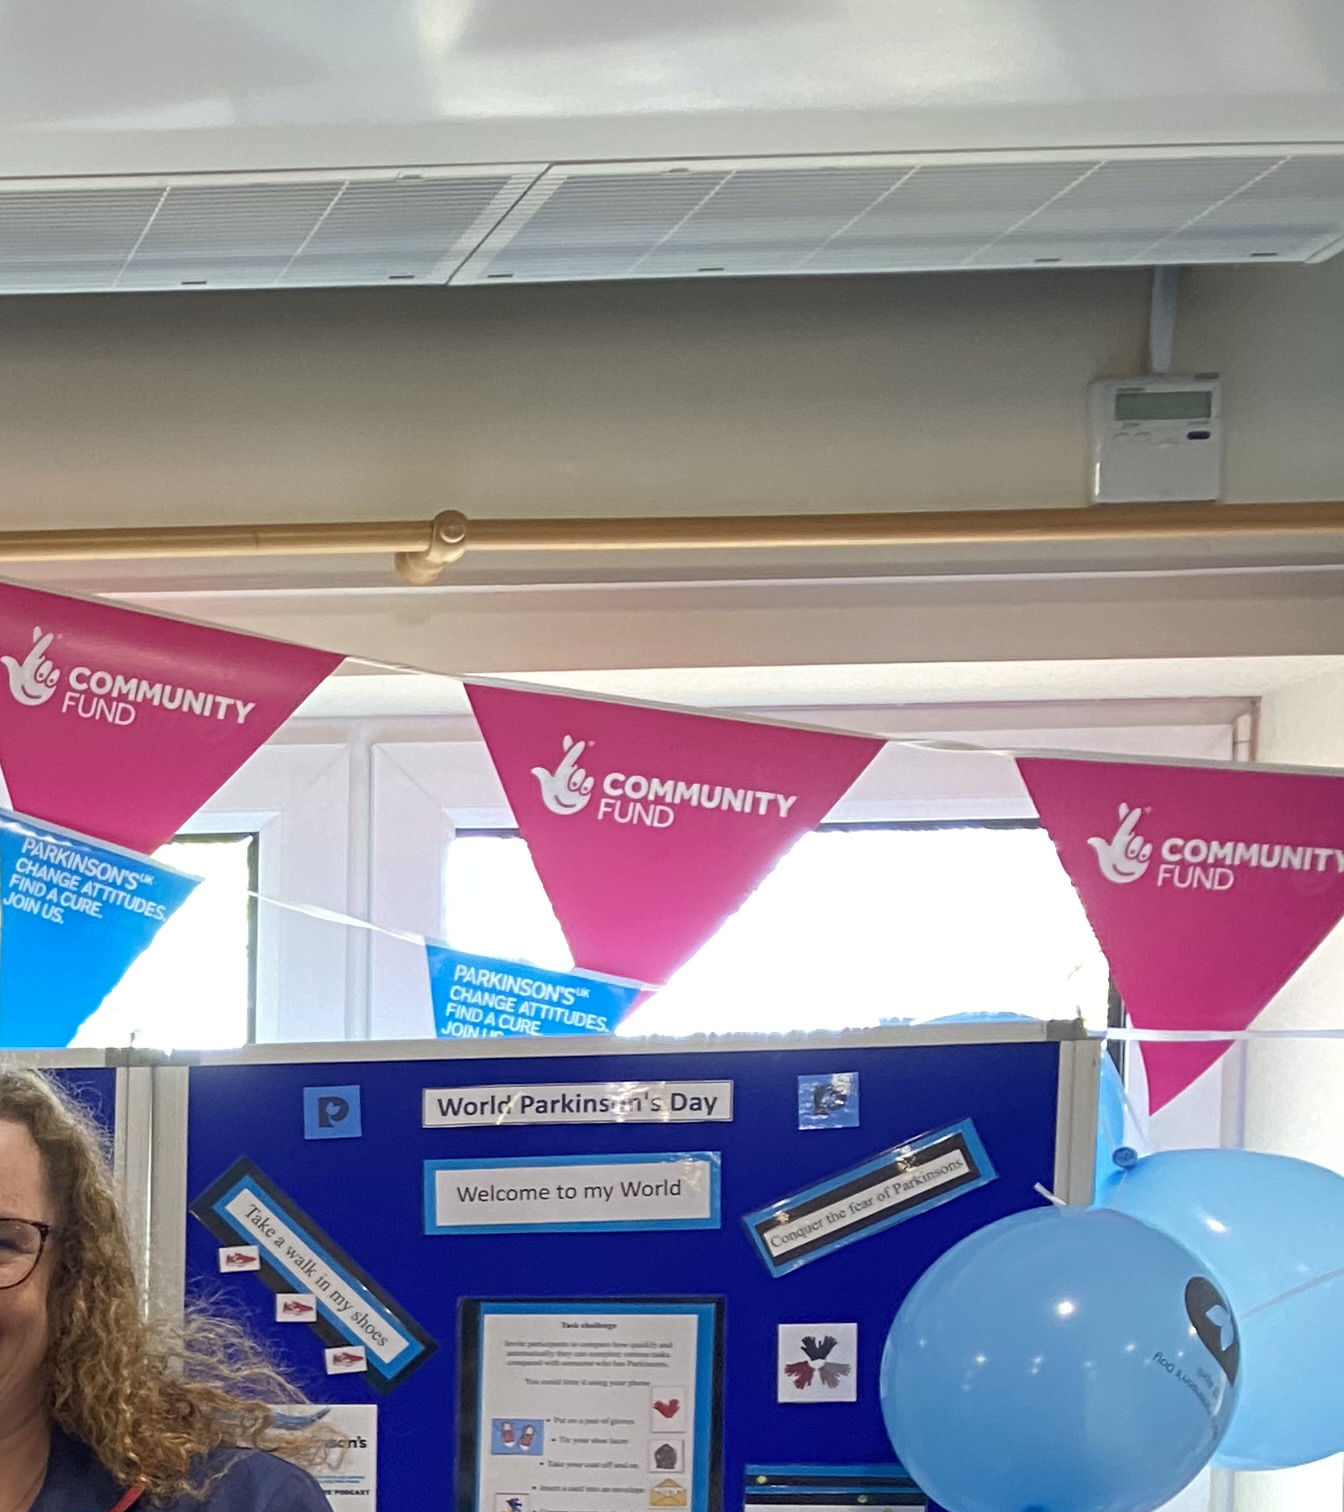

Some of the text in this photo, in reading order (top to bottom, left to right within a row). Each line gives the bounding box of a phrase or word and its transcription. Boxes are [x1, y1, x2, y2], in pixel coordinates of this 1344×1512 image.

[61, 692, 137, 727] FUND
[68, 665, 256, 726] COMMUNITY
[597, 796, 676, 831] FUND
[601, 770, 799, 821] COMMUNITY
[22, 838, 140, 890] PARKINSON'S
[1162, 838, 1344, 873] COMMUNITY
[9, 874, 103, 919] FIND CURE.
[16, 858, 166, 922] CHANGE ATTITUDES.
[1157, 864, 1235, 891] FUND
[3, 892, 64, 924] JOIN US.
[454, 964, 575, 1005] PARKINSON'S
[446, 1003, 483, 1023] FIND
[450, 986, 609, 1032] CHANGE ATTITUDES.
[438, 1092, 718, 1116] World Day
[457, 1179, 681, 1202] Welcome to my World
[770, 1196, 873, 1247] Conquer the fear
[245, 1203, 388, 1347] Take walk in my shoes
